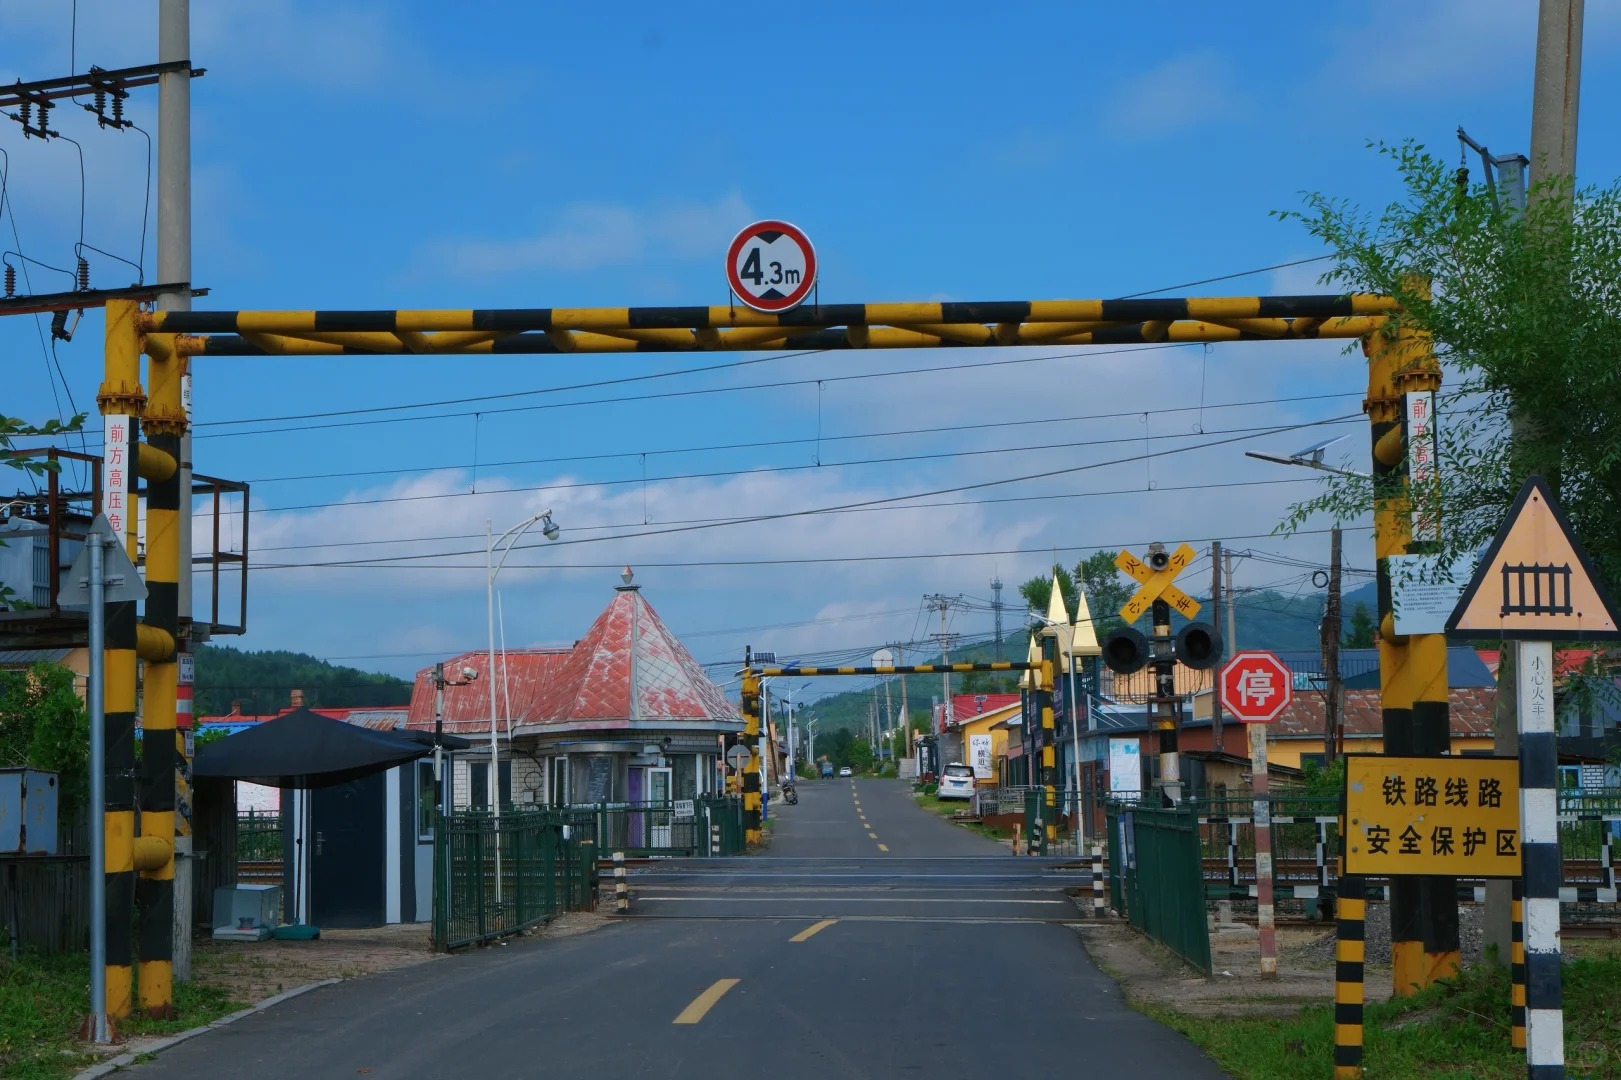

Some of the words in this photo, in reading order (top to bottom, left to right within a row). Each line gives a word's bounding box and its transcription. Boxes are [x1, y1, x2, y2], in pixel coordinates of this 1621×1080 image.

[740, 247, 800, 286] 4.3m
[1236, 668, 1275, 707] 停
[1531, 656, 1545, 715] 小心火车
[1382, 775, 1503, 808] 铁路线路
[1366, 824, 1518, 857] 安全保护区
